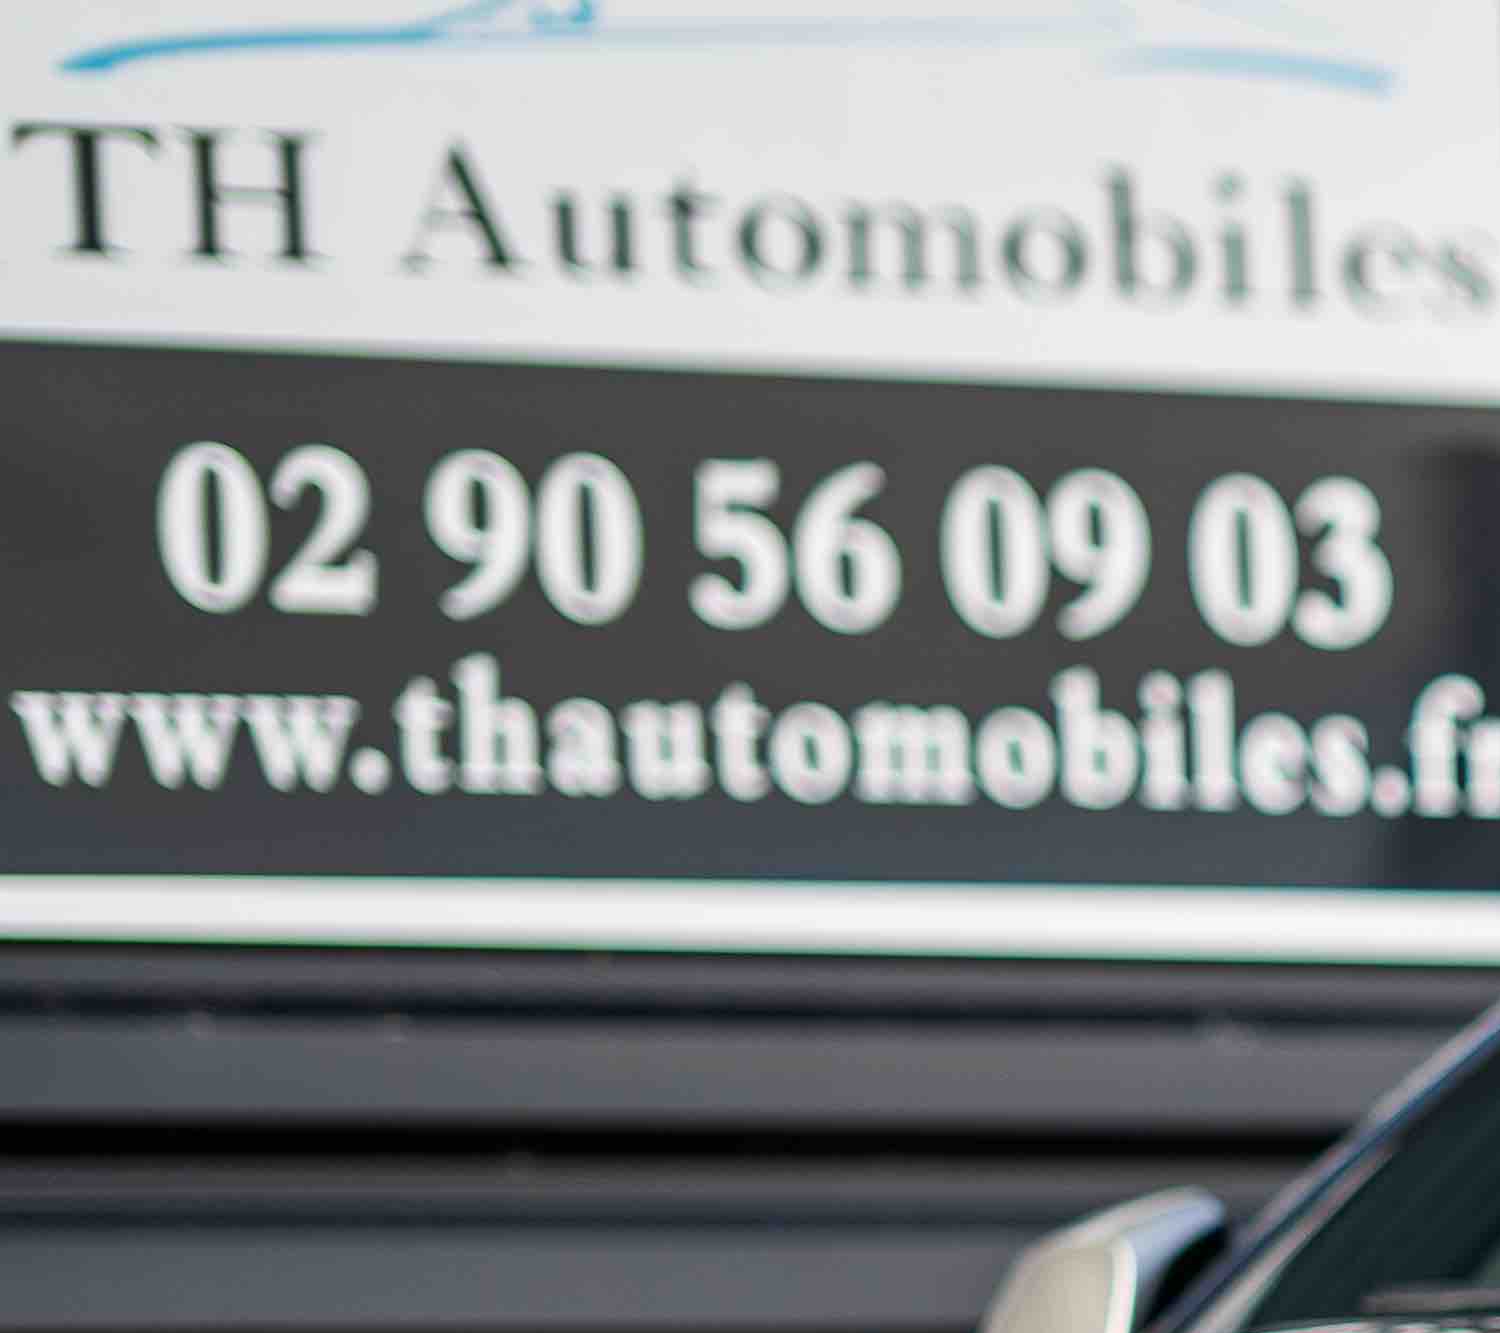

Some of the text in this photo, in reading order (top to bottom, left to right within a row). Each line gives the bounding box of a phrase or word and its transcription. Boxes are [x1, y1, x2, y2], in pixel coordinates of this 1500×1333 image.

[12, 121, 332, 266] TH
[154, 441, 1396, 651] 02 90 56 09 03
